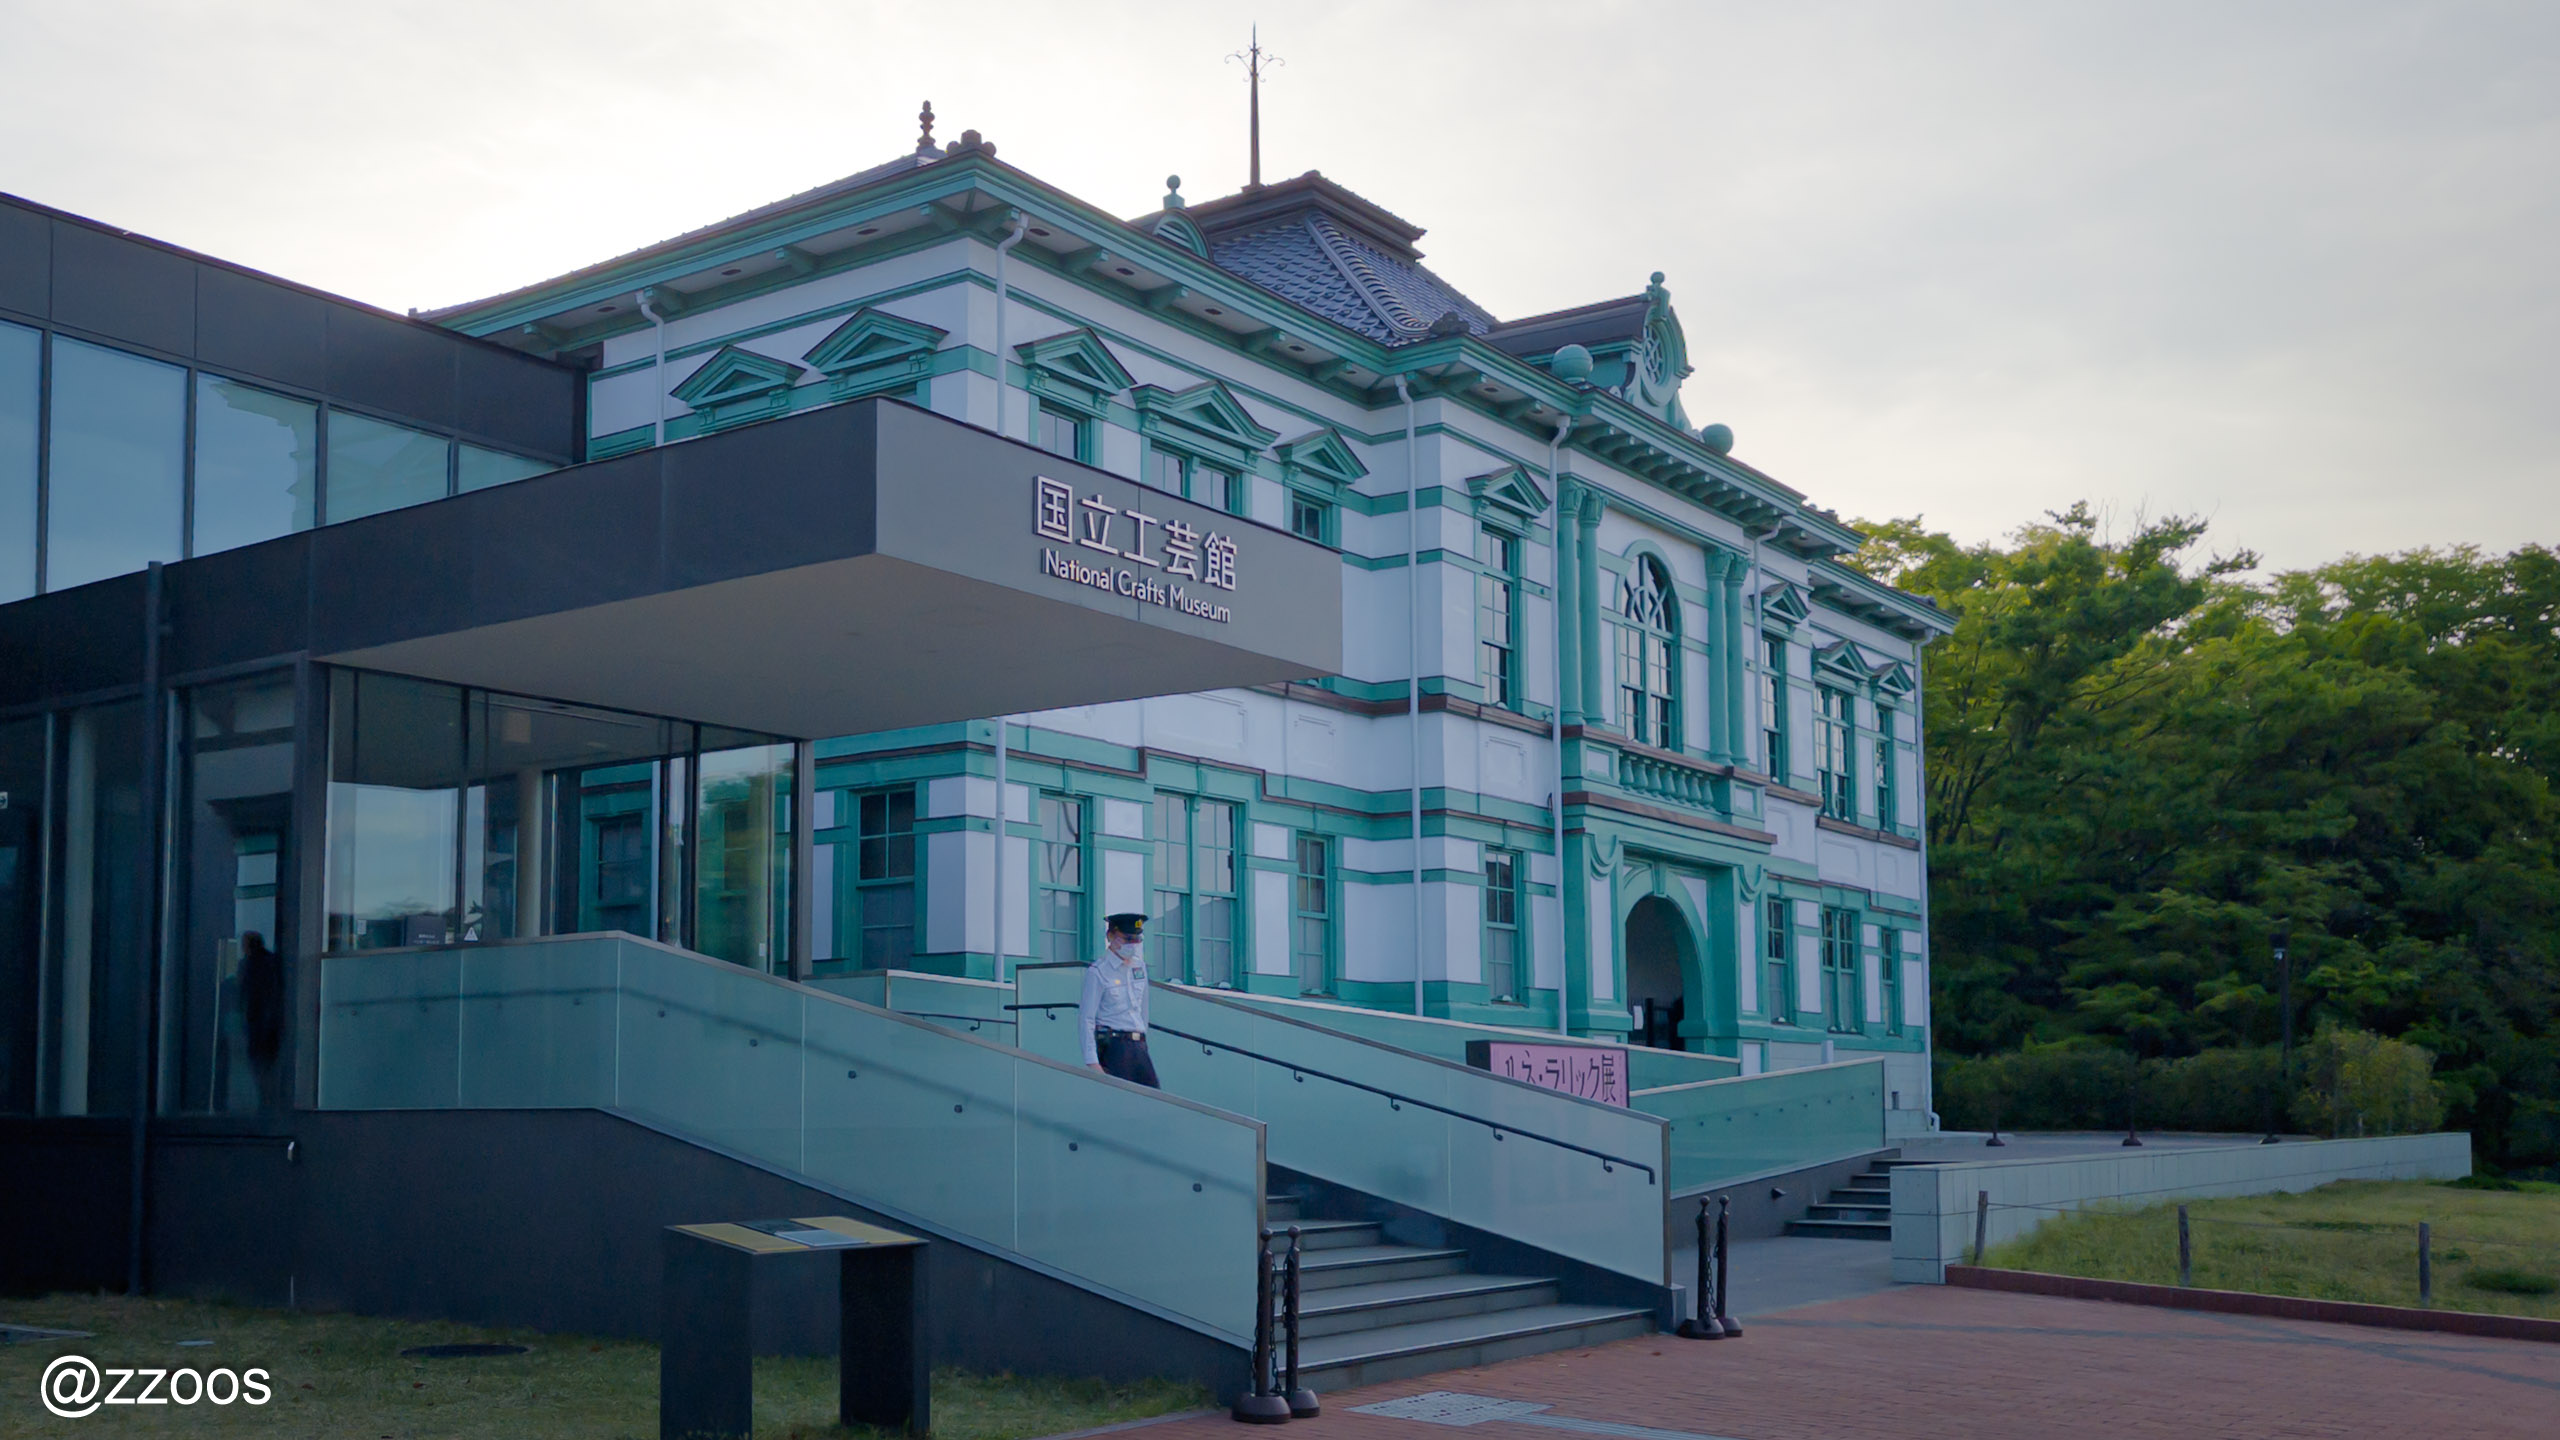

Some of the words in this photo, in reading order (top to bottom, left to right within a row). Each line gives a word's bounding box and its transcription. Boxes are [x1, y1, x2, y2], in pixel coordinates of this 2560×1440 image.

[1035, 474, 1238, 591] 国立工芸館
[1043, 547, 1114, 592] National
[1117, 569, 1166, 606] Crafts
[1169, 583, 1231, 624] Museum
